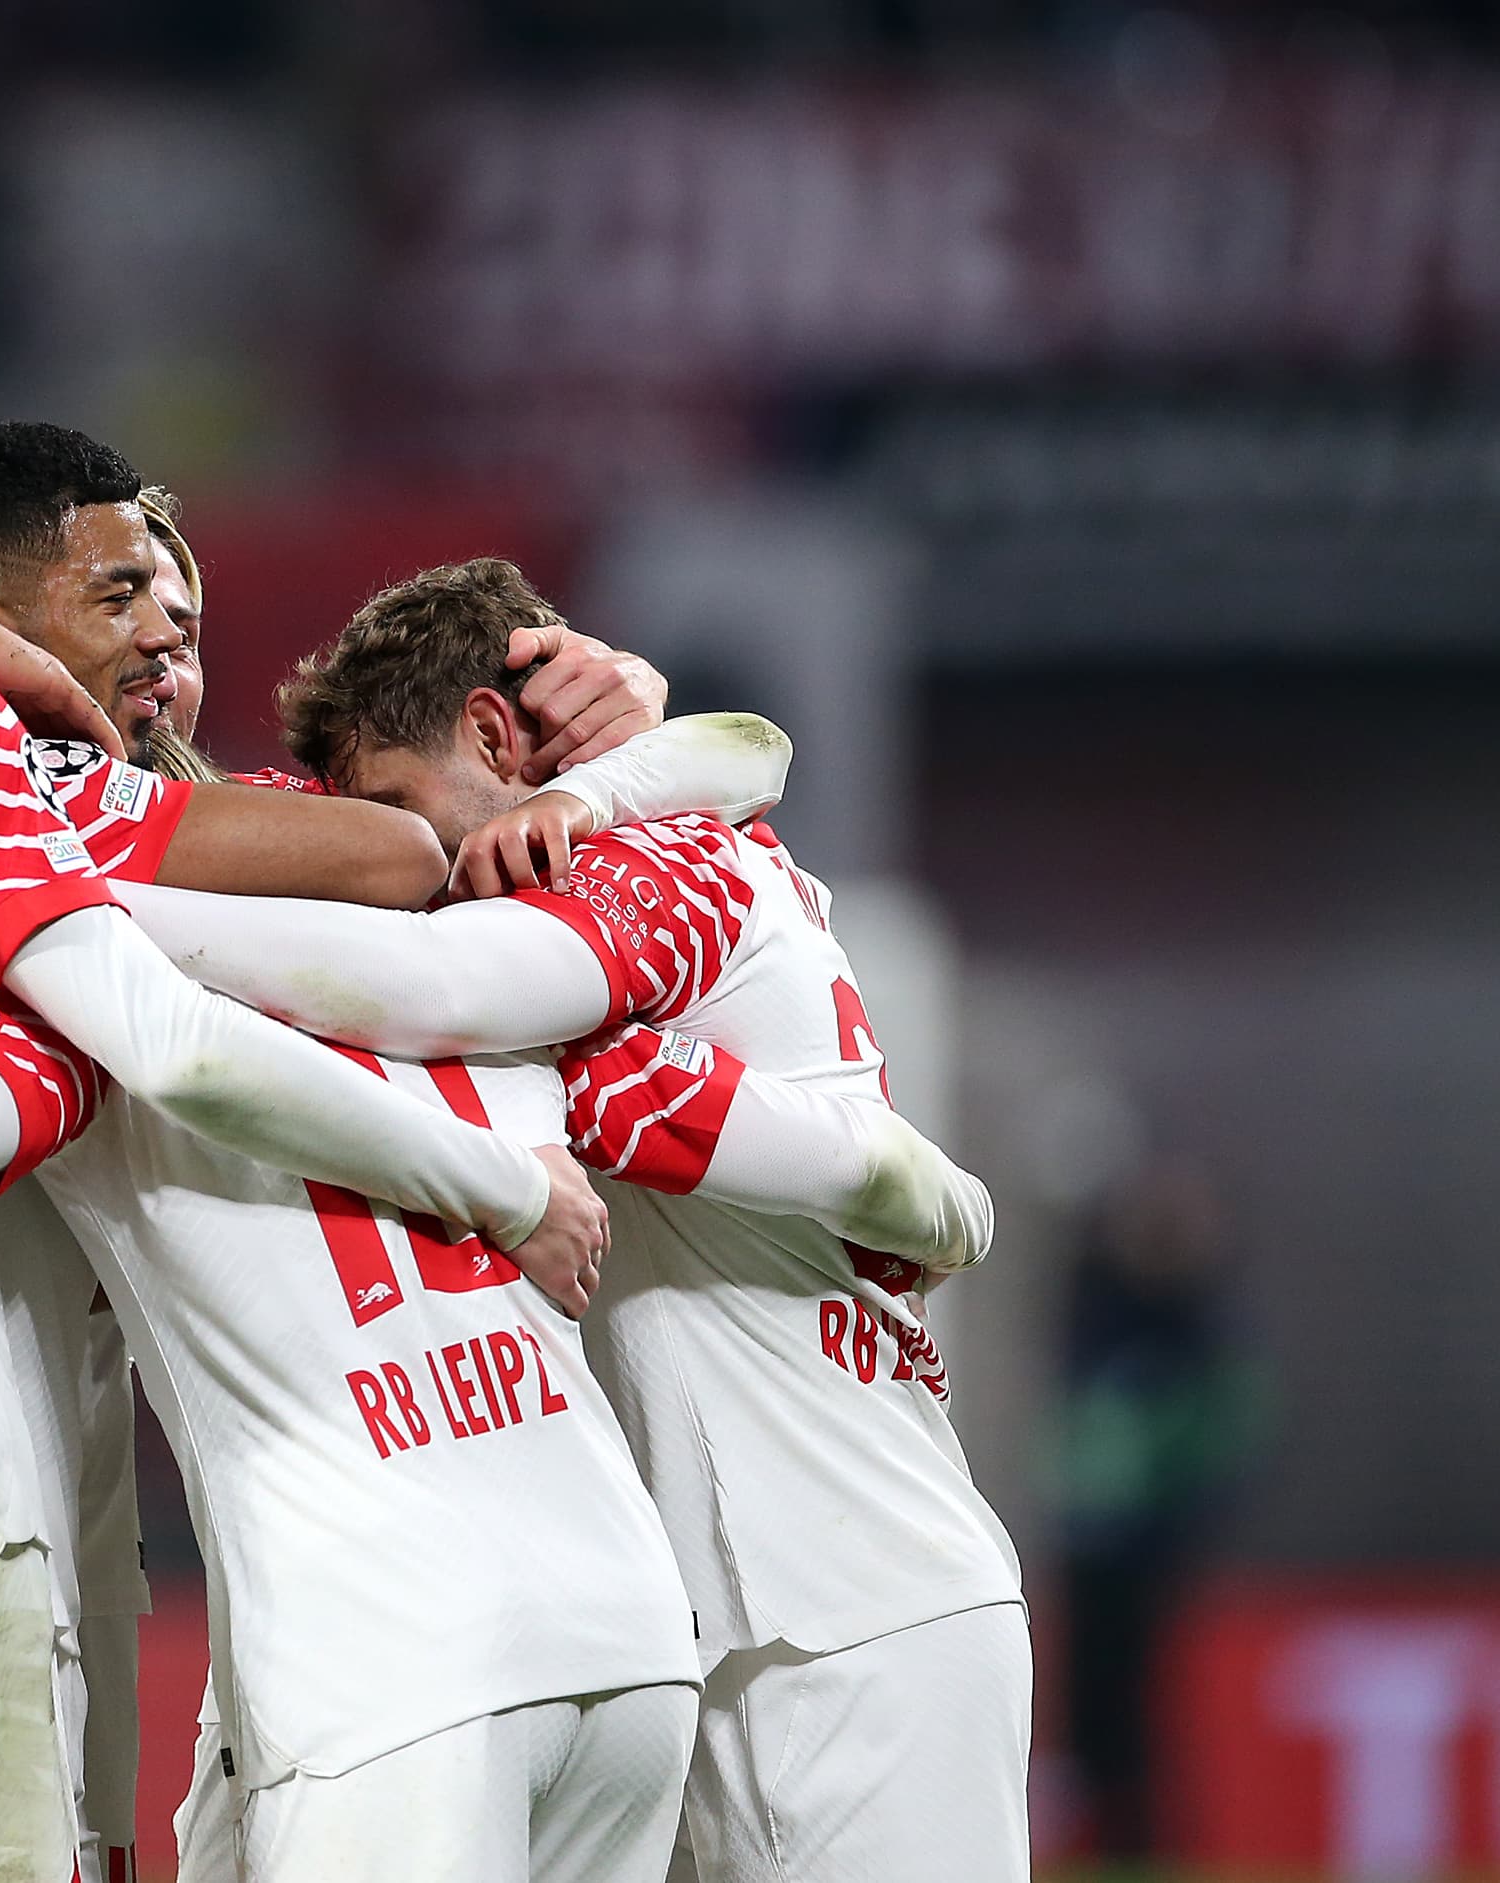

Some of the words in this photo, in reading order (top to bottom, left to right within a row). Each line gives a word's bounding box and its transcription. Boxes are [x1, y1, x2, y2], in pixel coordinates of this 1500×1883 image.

[560, 883, 642, 950] SORTS
[569, 871, 638, 921] OTELS
[819, 1298, 879, 1385] RB
[345, 1361, 431, 1460] RB
[424, 1325, 569, 1440] LEIPZ
